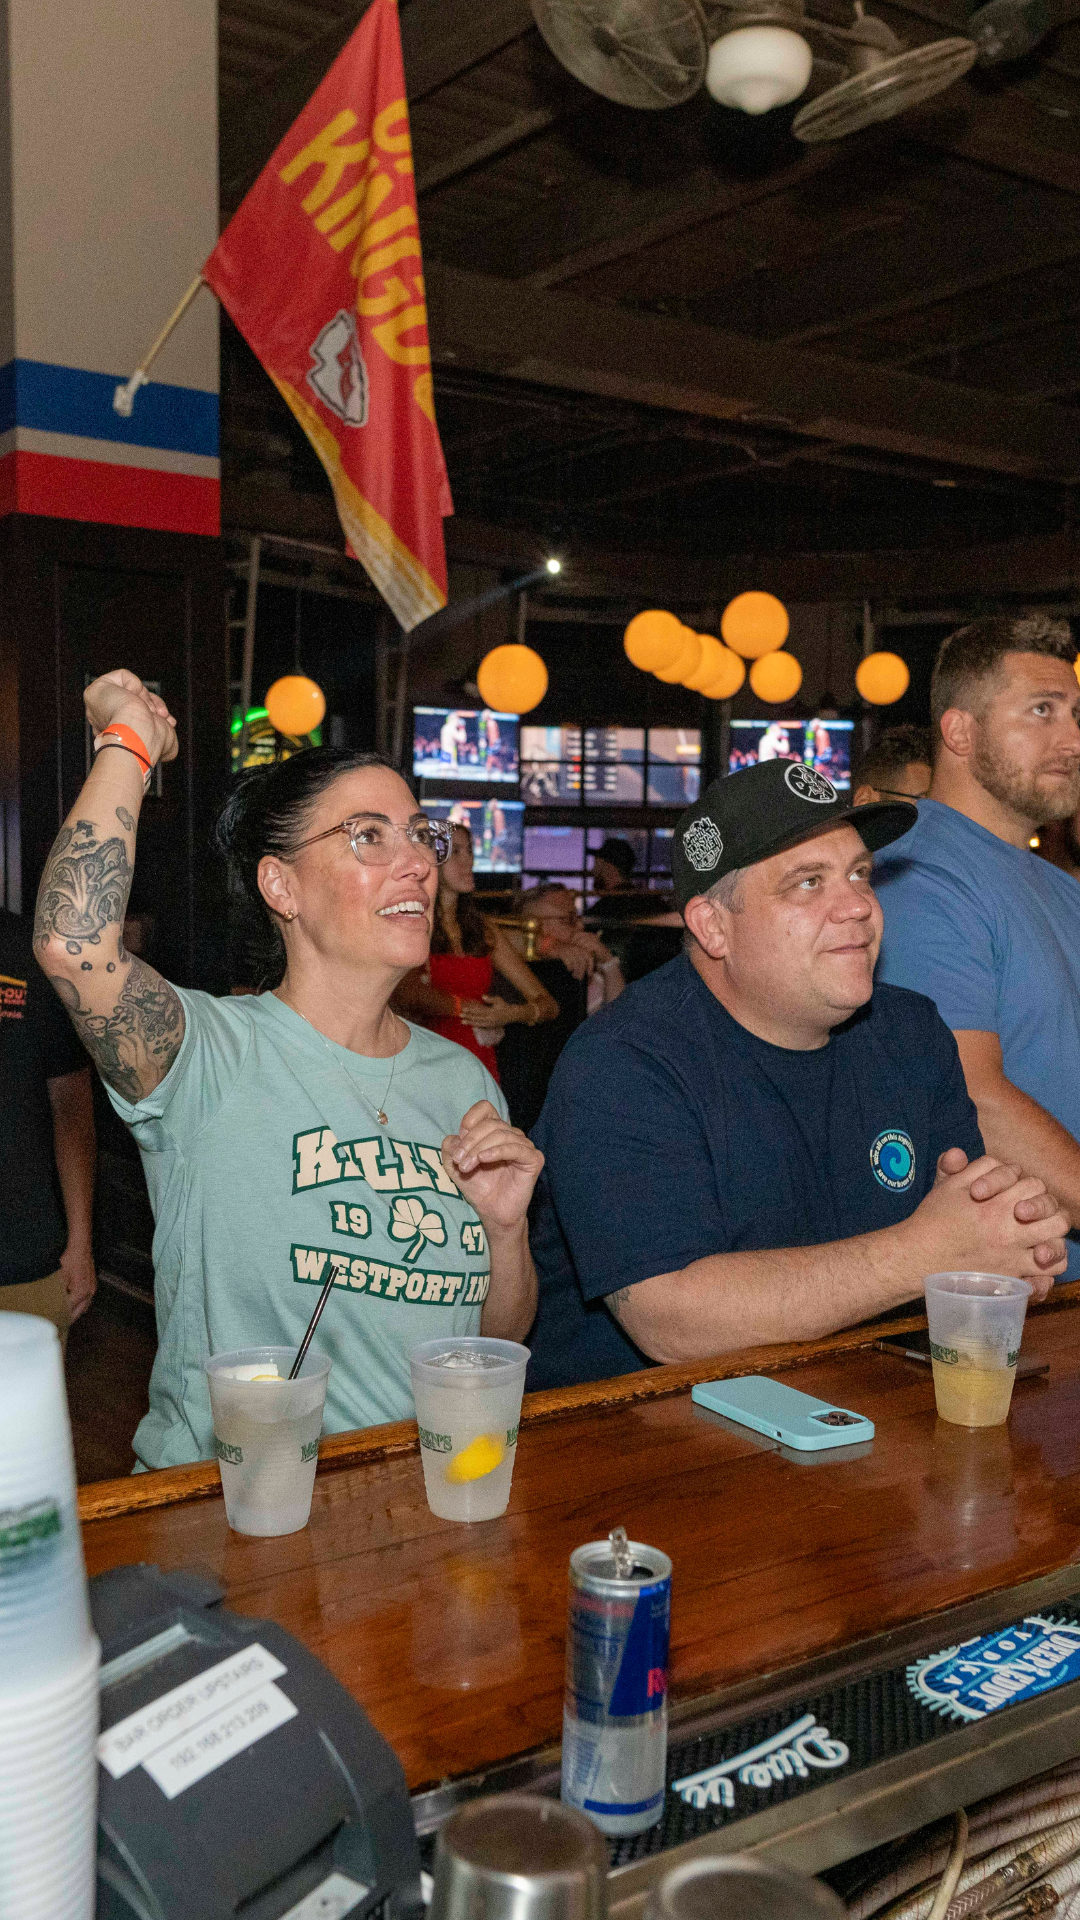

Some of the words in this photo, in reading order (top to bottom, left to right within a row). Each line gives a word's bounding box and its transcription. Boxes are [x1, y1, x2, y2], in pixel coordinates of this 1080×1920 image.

[329, 1201, 372, 1240] 19
[460, 1221, 485, 1255] 47
[289, 1243, 466, 1306] WESTPORT
[944, 1630, 1032, 1686] VODKA
[1023, 1634, 1080, 1670] DEEP
[968, 1670, 1036, 1710] EDDY
[739, 1726, 850, 1788] Dive
[681, 1776, 736, 1810] in
